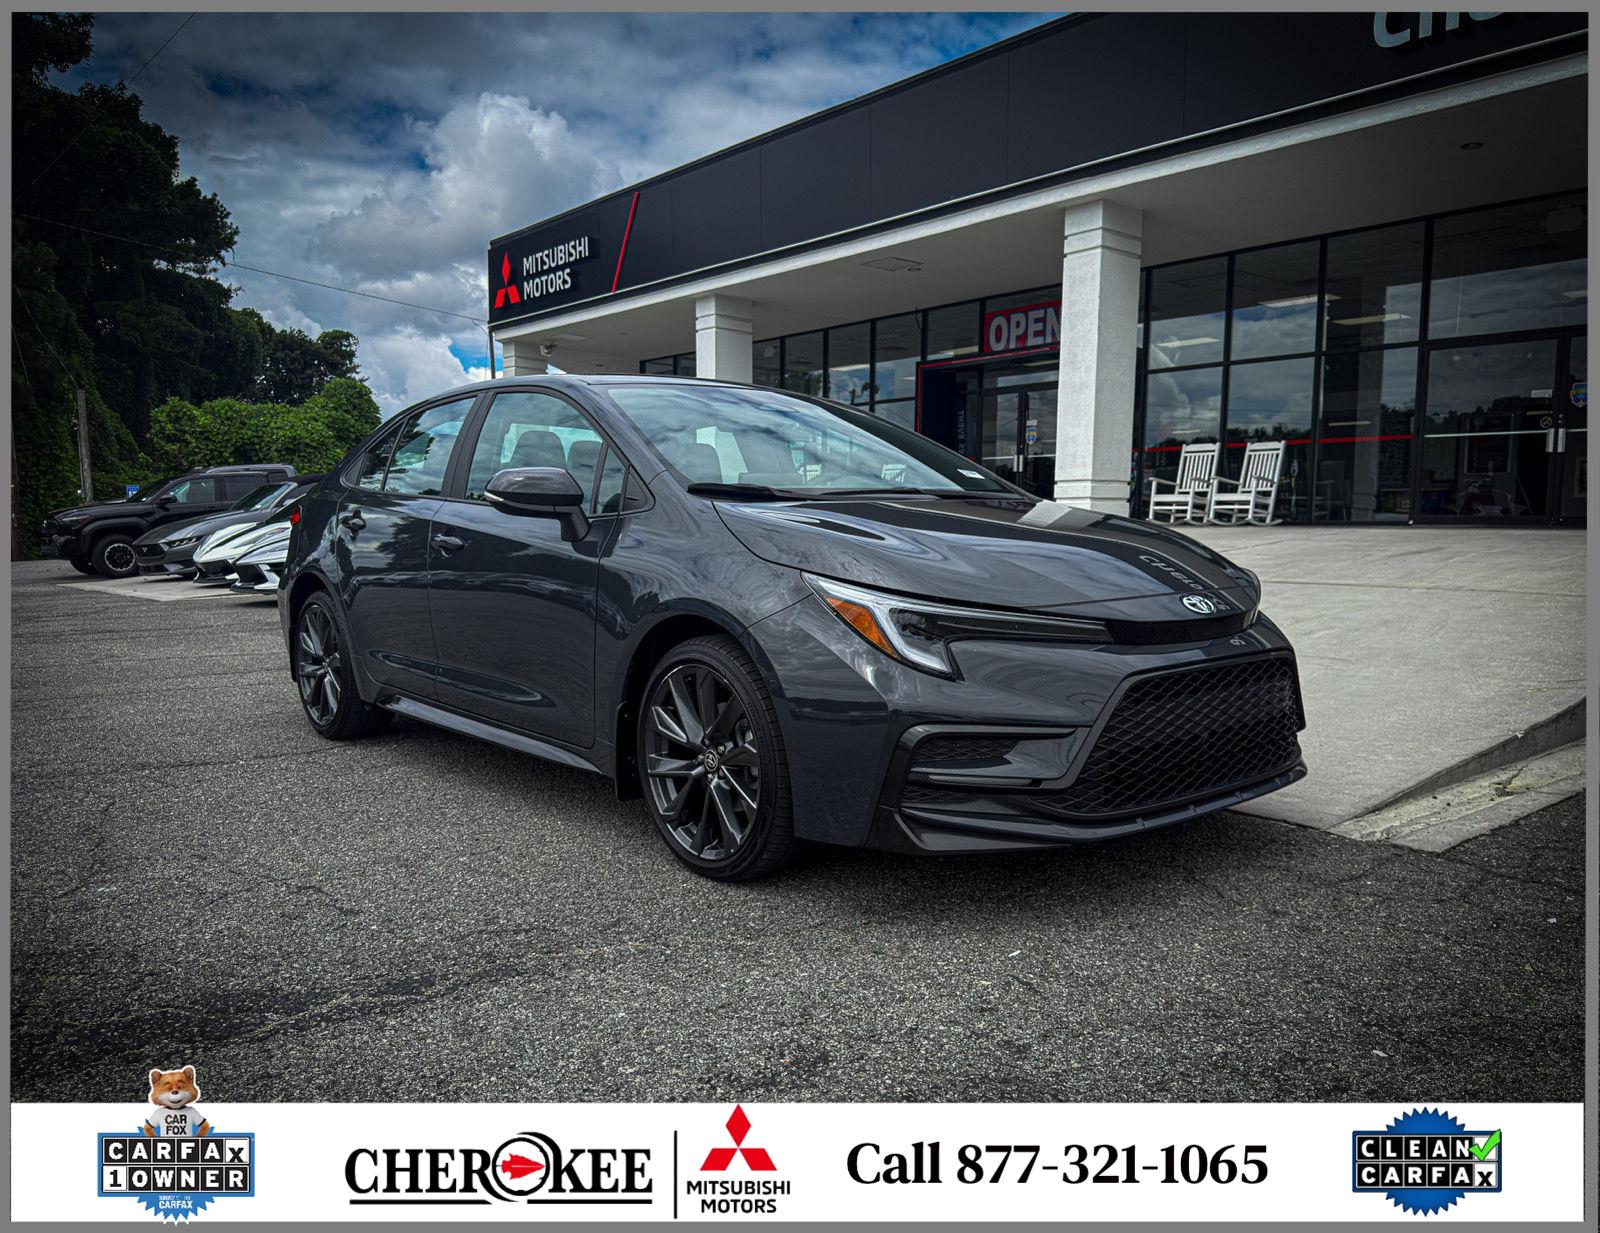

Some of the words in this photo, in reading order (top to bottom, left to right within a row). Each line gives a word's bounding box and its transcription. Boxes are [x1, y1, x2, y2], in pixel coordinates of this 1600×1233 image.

[523, 236, 589, 276] MITSUBISHI
[524, 268, 571, 300] MOTORS
[989, 307, 1061, 351] OPEN
